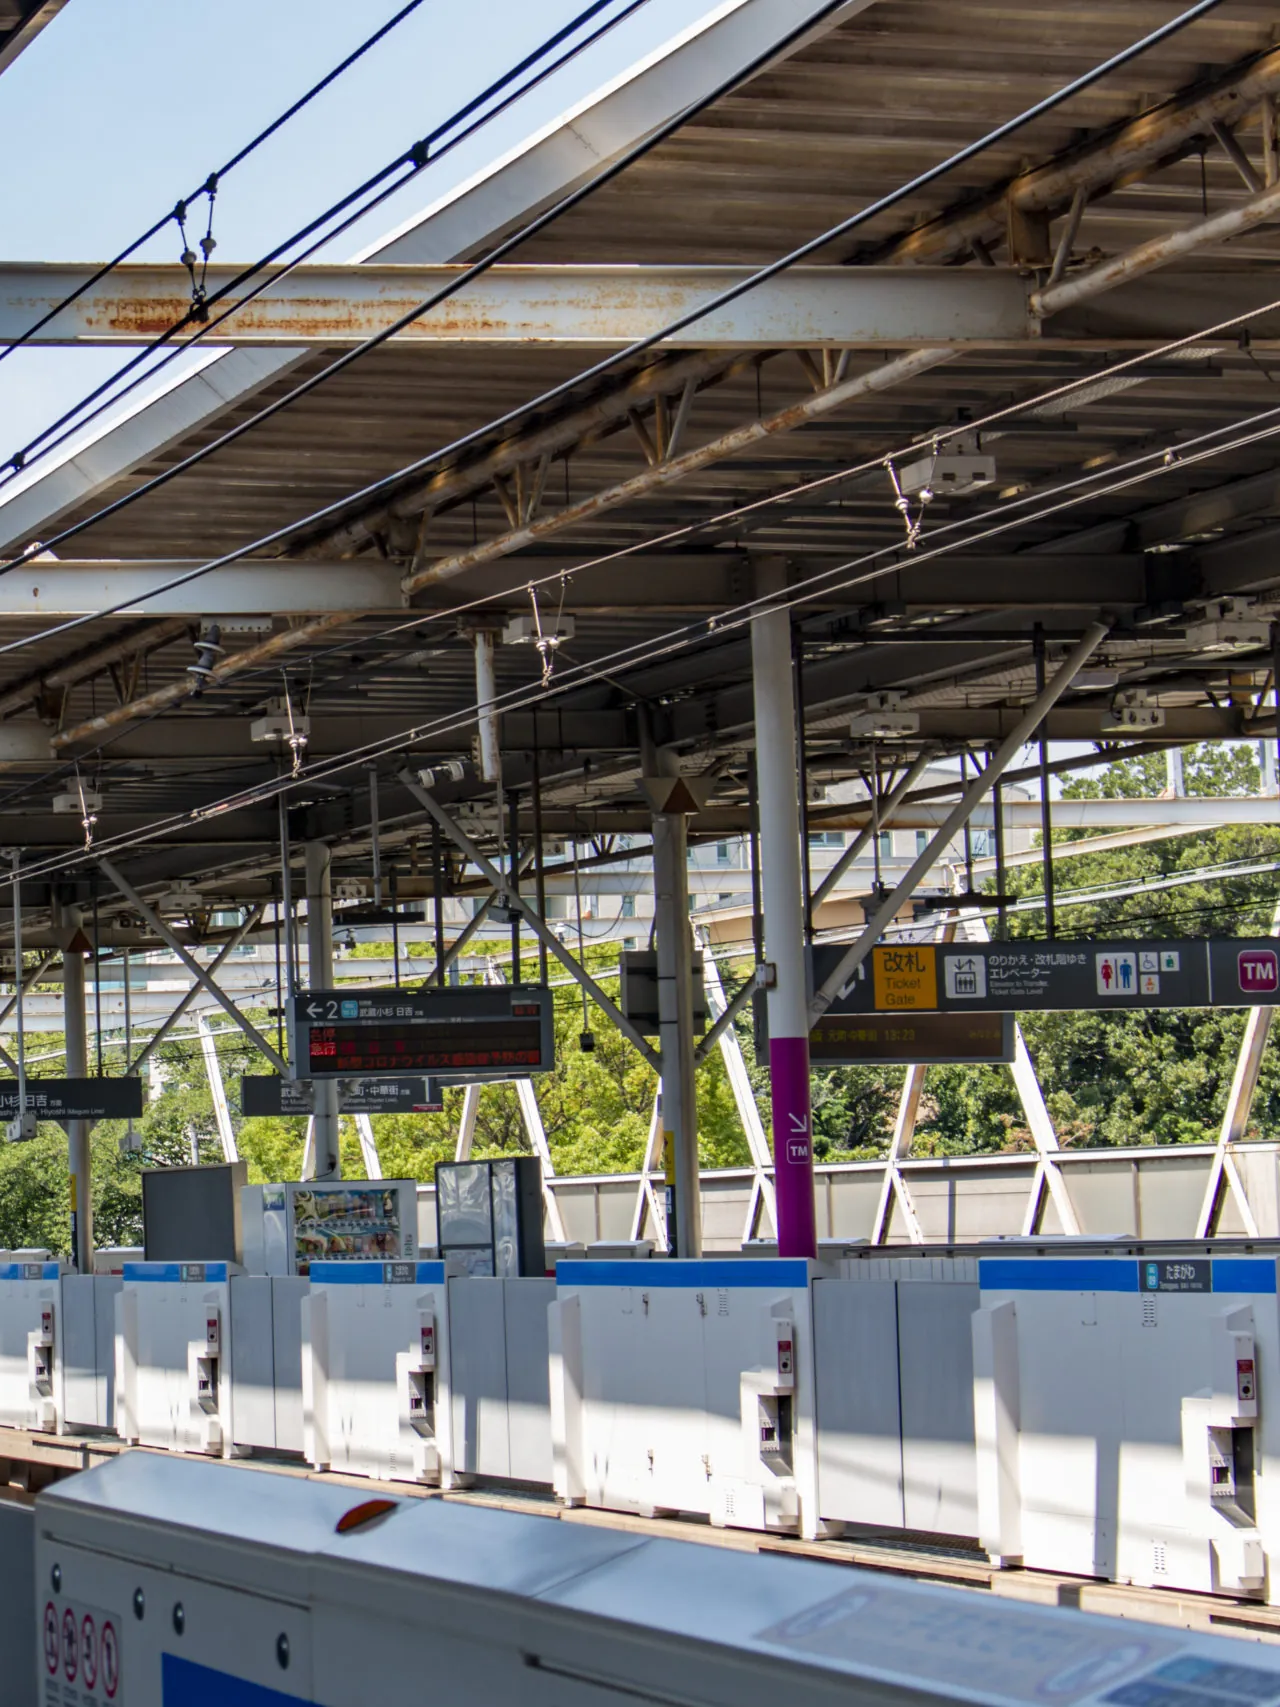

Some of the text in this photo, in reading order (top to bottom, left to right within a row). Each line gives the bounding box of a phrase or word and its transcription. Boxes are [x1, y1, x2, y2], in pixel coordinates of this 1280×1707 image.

[882, 950, 926, 973] 改札
[989, 967, 1052, 979] エレベーター
[1242, 962, 1274, 980] TM
[884, 977, 921, 989] Ticket
[884, 993, 916, 1006] Gate
[325, 1000, 338, 1019] 2
[396, 1007, 413, 1016] 日吉
[24, 1094, 48, 1107] 日吉
[790, 1145, 808, 1157] TM
[1166, 1263, 1196, 1280] たまがわ
